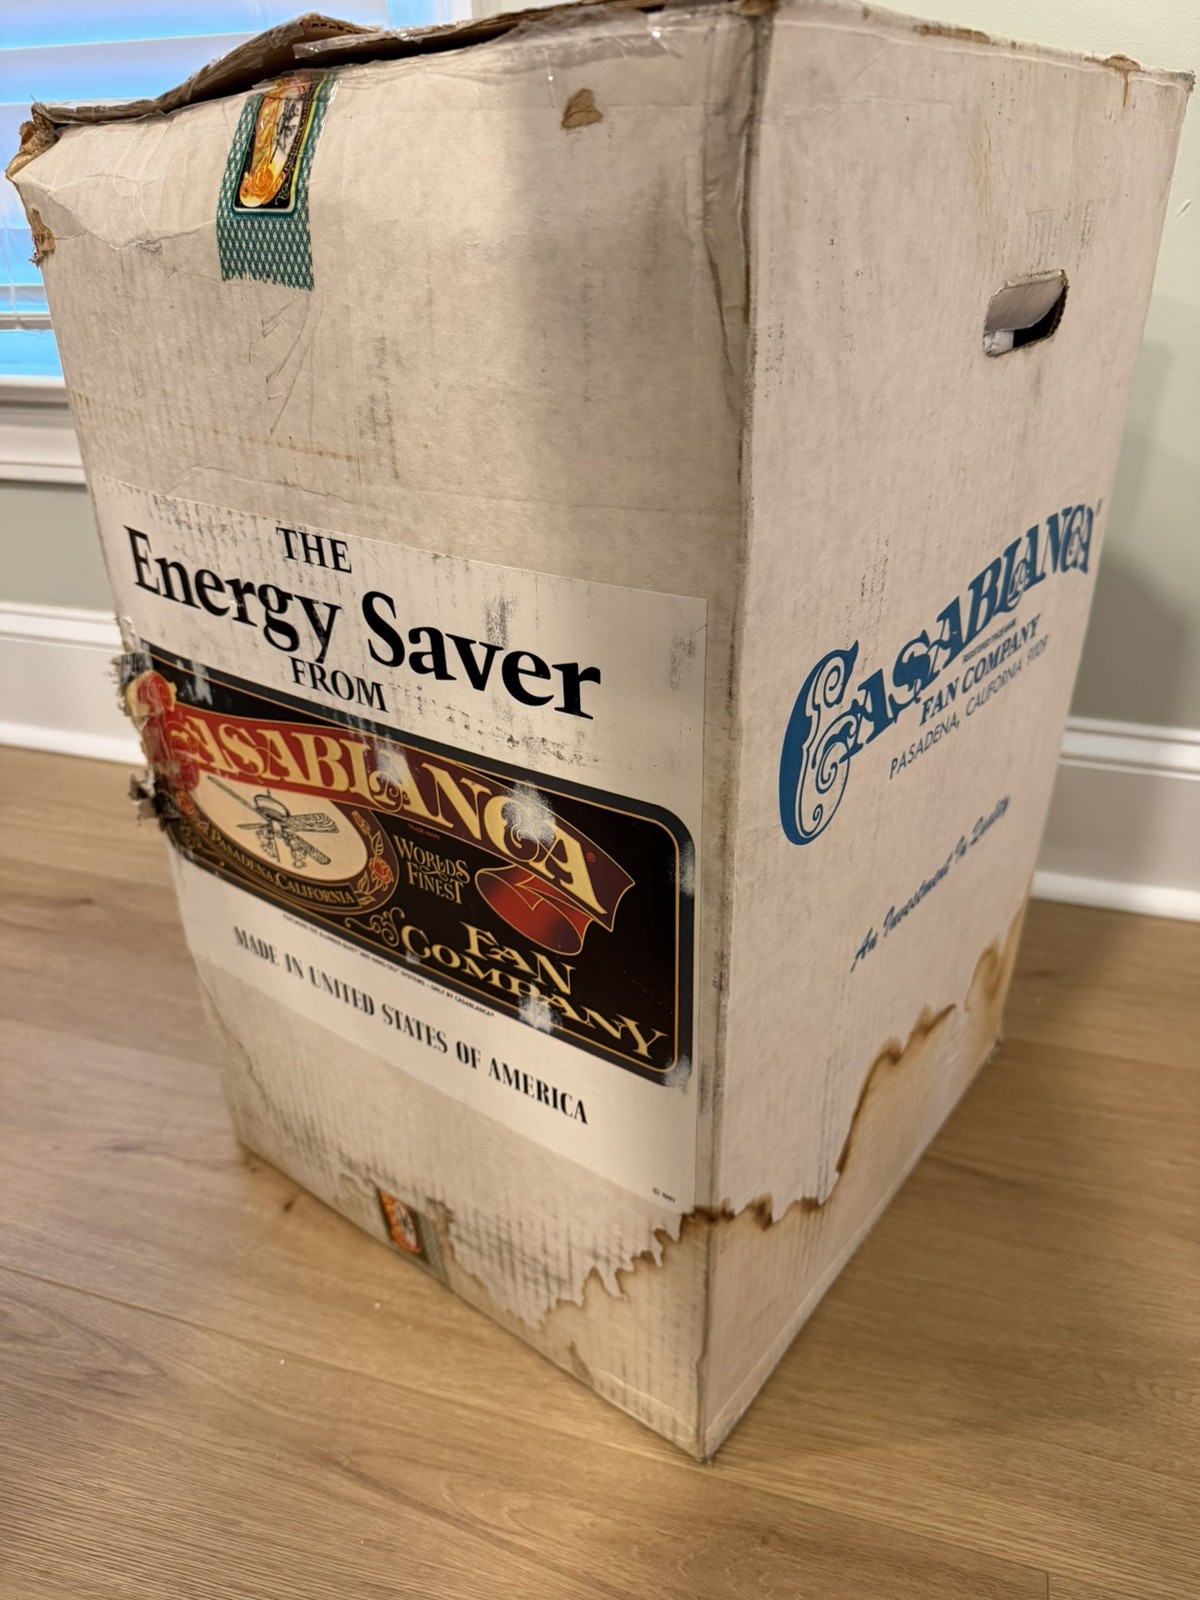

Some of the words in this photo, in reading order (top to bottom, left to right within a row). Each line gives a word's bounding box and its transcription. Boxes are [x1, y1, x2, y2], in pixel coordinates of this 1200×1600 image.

[276, 526, 352, 574] THE
[123, 525, 342, 664] Energy
[361, 591, 601, 720] Saver
[920, 677, 959, 726] FAN
[962, 613, 1041, 694] COMPANY
[288, 656, 390, 713] FROM
[779, 503, 1094, 845] CASABLANCA
[889, 711, 960, 780] PASADENA,
[966, 659, 1022, 716] CALIFORNIA
[210, 832, 275, 883] PASADENA
[275, 872, 356, 904] CALIFORNIA
[407, 861, 463, 905] FINEST
[401, 925, 669, 1058] COMPANY
[460, 921, 577, 996] FAN
[850, 927, 878, 972] An
[234, 925, 279, 966] MADE
[285, 953, 304, 979] IN
[309, 966, 375, 1015] UNITED
[382, 1003, 448, 1053] STATES
[456, 1041, 482, 1069] OF
[488, 1057, 588, 1124] AMERICA
